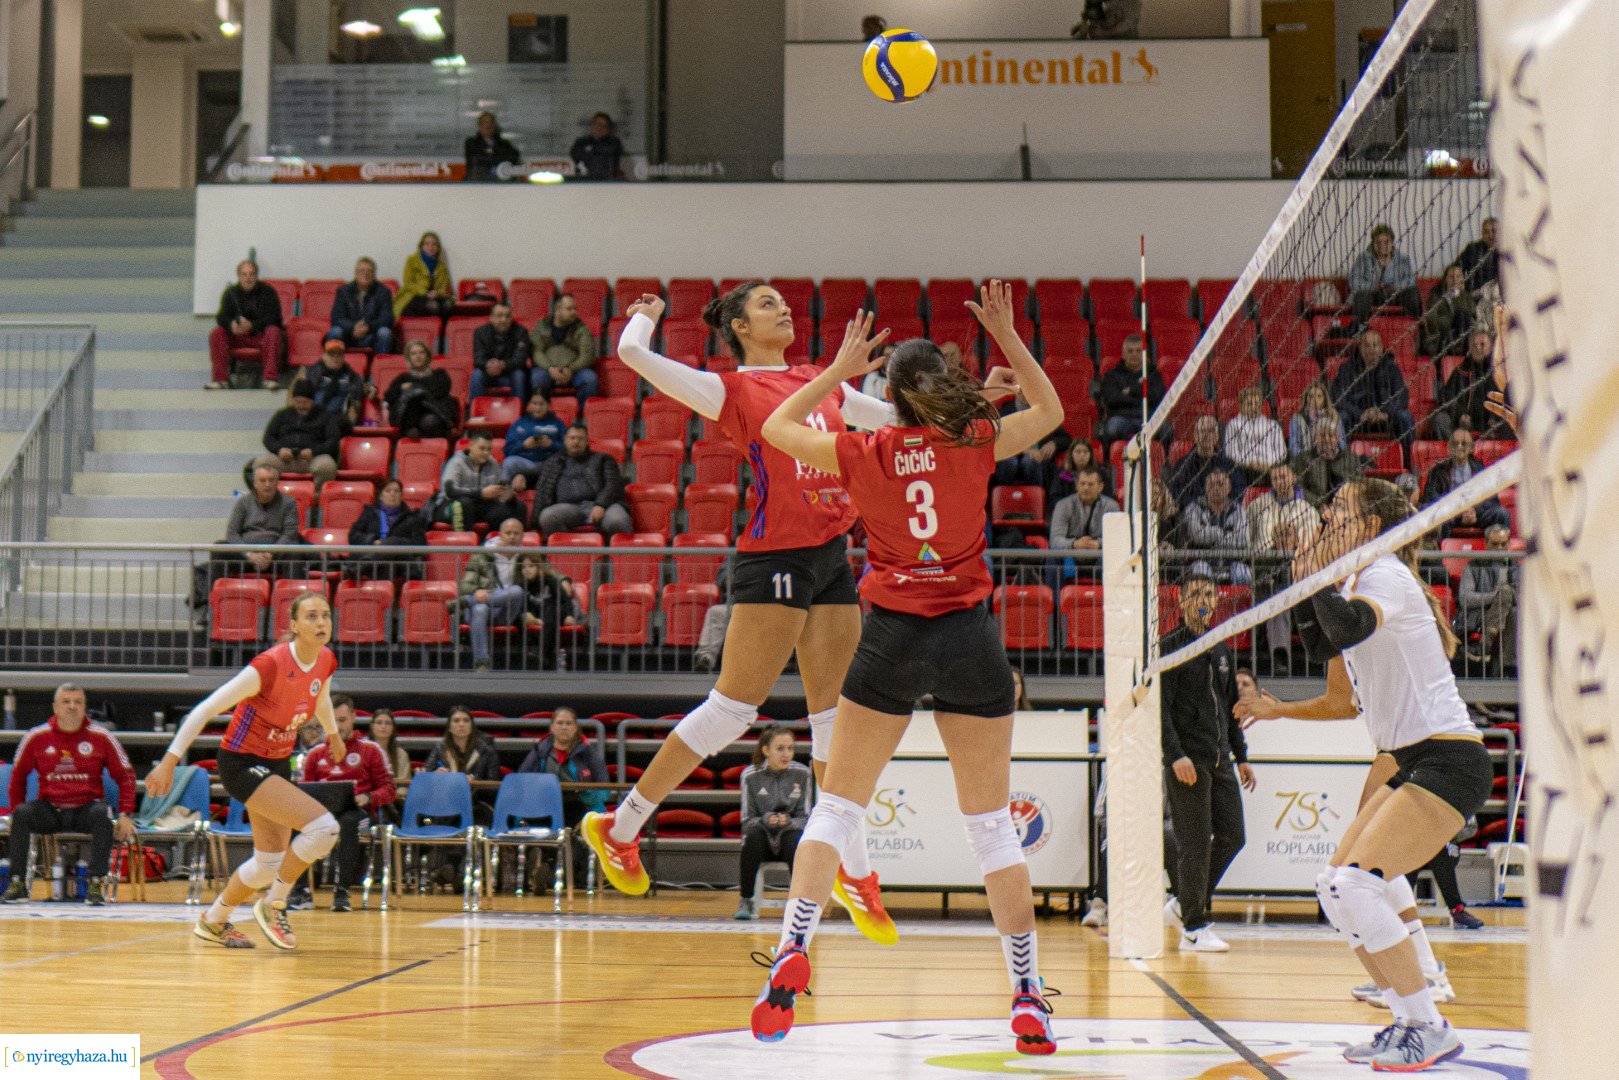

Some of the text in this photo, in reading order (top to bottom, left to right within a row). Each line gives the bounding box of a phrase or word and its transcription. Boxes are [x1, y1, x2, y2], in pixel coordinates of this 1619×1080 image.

[939, 49, 1123, 85] ntinental
[360, 161, 440, 181] Continental
[894, 446, 937, 477] ČIČIĆ
[905, 479, 939, 541] 3
[772, 572, 792, 600] 11
[865, 837, 925, 851] PLABDA
